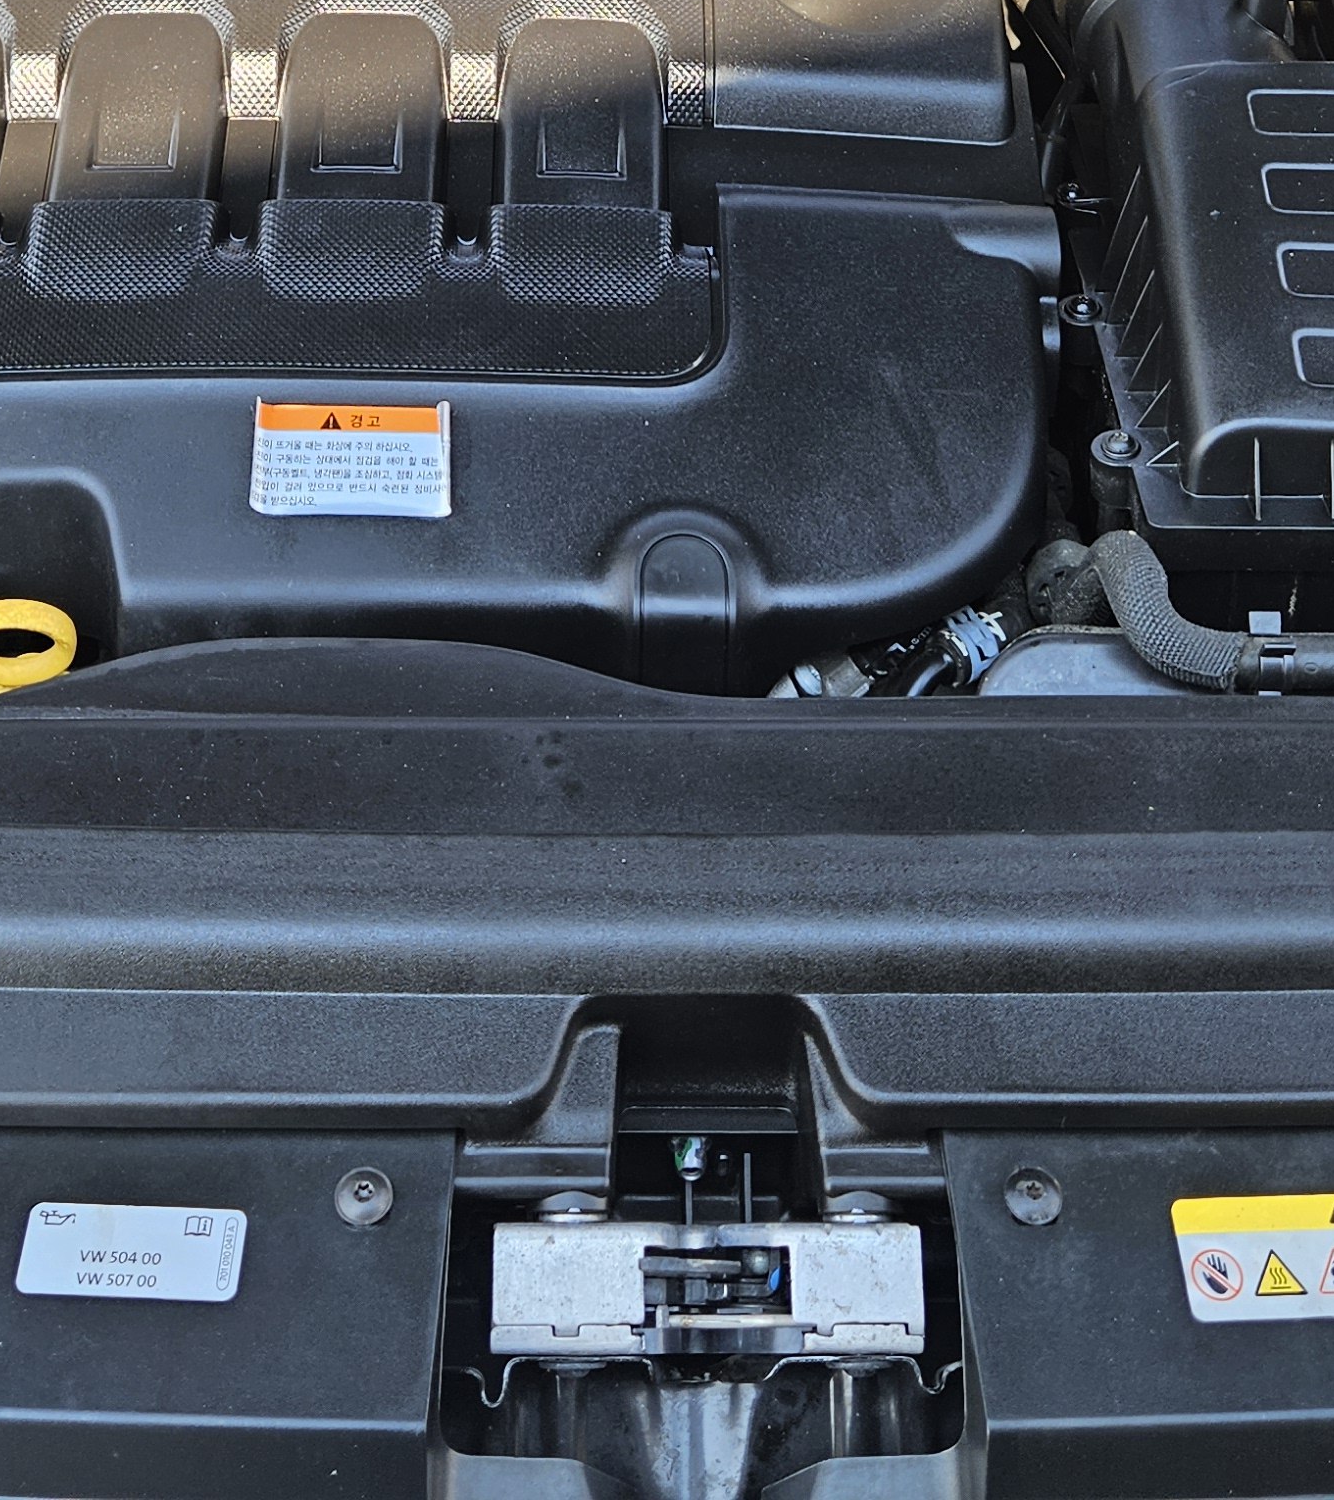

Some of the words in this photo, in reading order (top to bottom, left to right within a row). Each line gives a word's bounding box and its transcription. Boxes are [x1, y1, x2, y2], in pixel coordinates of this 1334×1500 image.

[350, 414, 381, 429] 경고
[275, 439, 302, 451] 뜨거울
[305, 440, 323, 451] 때는
[326, 440, 352, 452] 화상에
[355, 441, 373, 452] 주의
[276, 453, 311, 465] 구동하는
[356, 455, 381, 466] 점검을
[386, 456, 404, 466] 해야
[422, 456, 439, 467] 때는
[308, 481, 343, 493] 있으므로
[349, 483, 377, 494] 반드시
[382, 483, 409, 494] 숙련된
[80, 1250, 106, 1263] VW
[110, 1251, 137, 1265] 504
[141, 1252, 162, 1265] 00
[77, 1272, 104, 1285] VW
[106, 1273, 134, 1287] 507
[136, 1274, 157, 1288] 00
